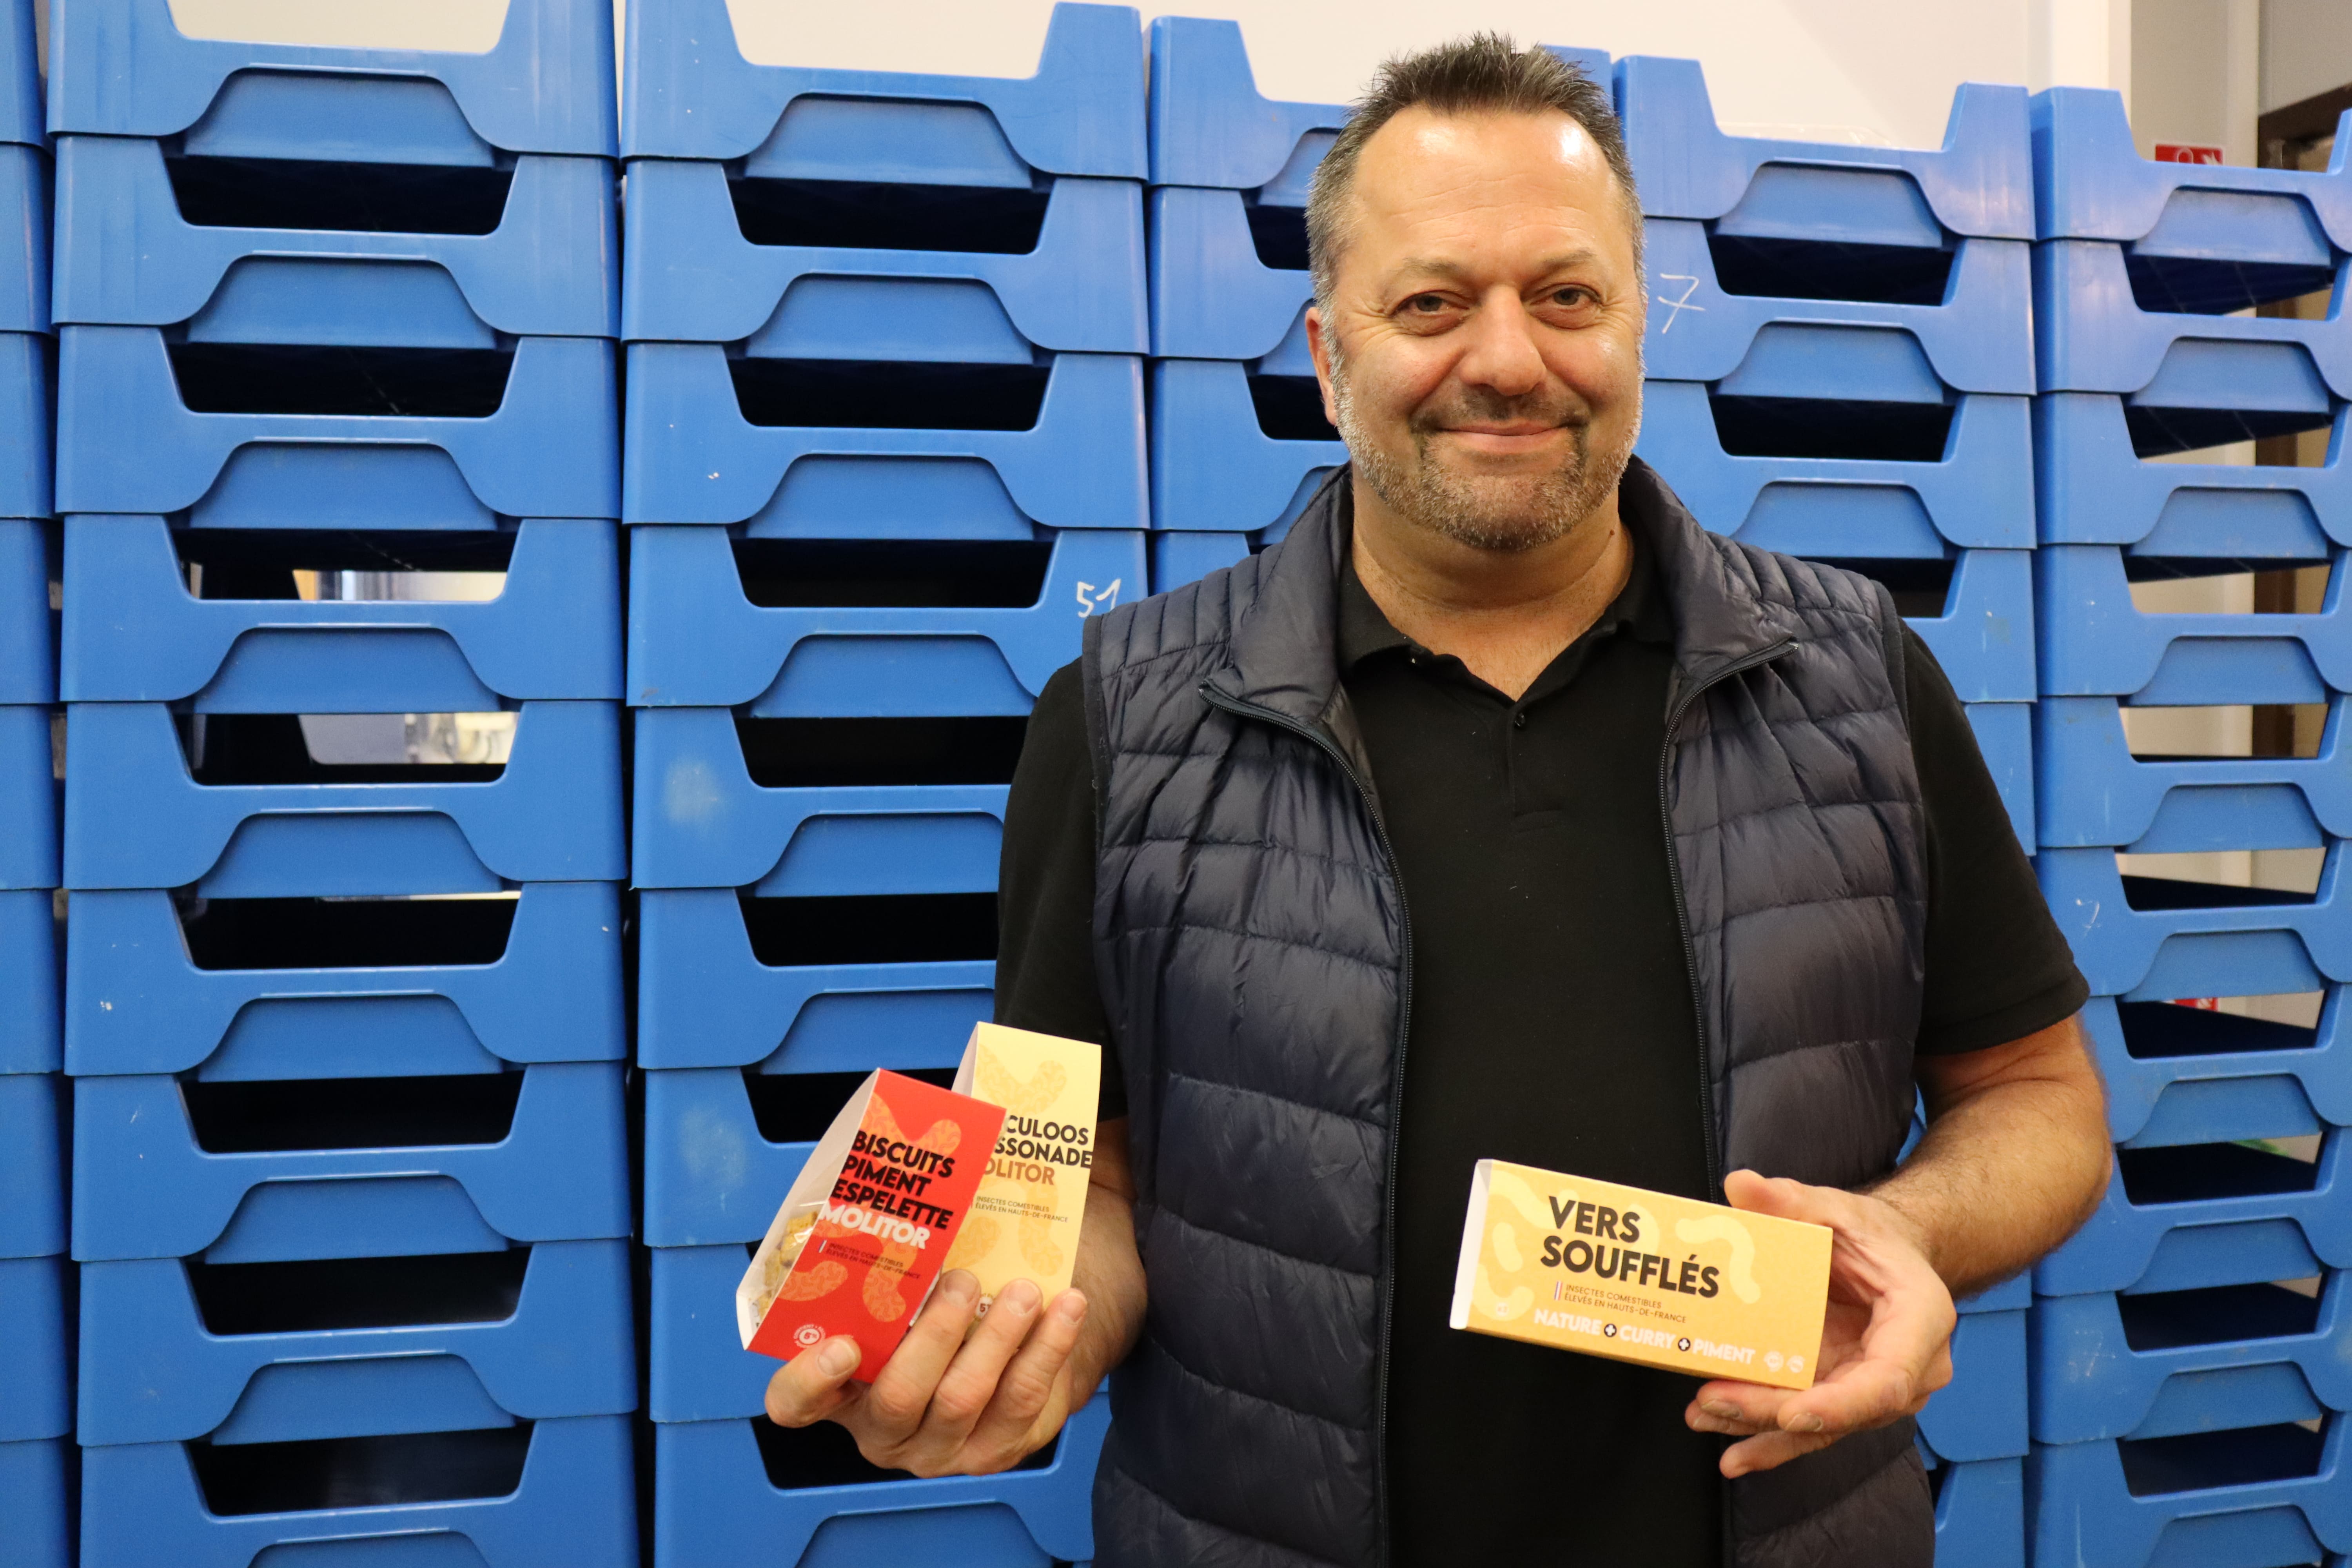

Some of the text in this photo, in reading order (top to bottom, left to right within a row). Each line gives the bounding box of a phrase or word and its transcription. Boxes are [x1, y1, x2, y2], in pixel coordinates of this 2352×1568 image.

[1657, 273, 1706, 334] 7
[1077, 578, 1121, 618] 51
[841, 1154, 932, 1196] PIMENT
[851, 1130, 955, 1178] BISCUITS
[819, 1201, 931, 1249] MOLITOR
[831, 1179, 954, 1229] ESPELETTE
[975, 1202, 997, 1211] ÉLEVÉS
[1008, 1209, 1068, 1223] HAUTS-DE-FRANCE
[977, 1196, 1049, 1212] INSECTES COMESTIBLES
[1549, 1196, 1641, 1243] VERS
[1541, 1235, 1720, 1298] SOUFFLÉS
[1564, 1293, 1592, 1305] ÉLEVÉS
[1607, 1302, 1687, 1323] HAUTS-DE-FRANCE
[1566, 1285, 1662, 1309] INSECTES COMESTIBLES
[1534, 1308, 1602, 1336] NATURE
[1619, 1325, 1676, 1349] CURRY
[1692, 1338, 1756, 1365] PIMENT
